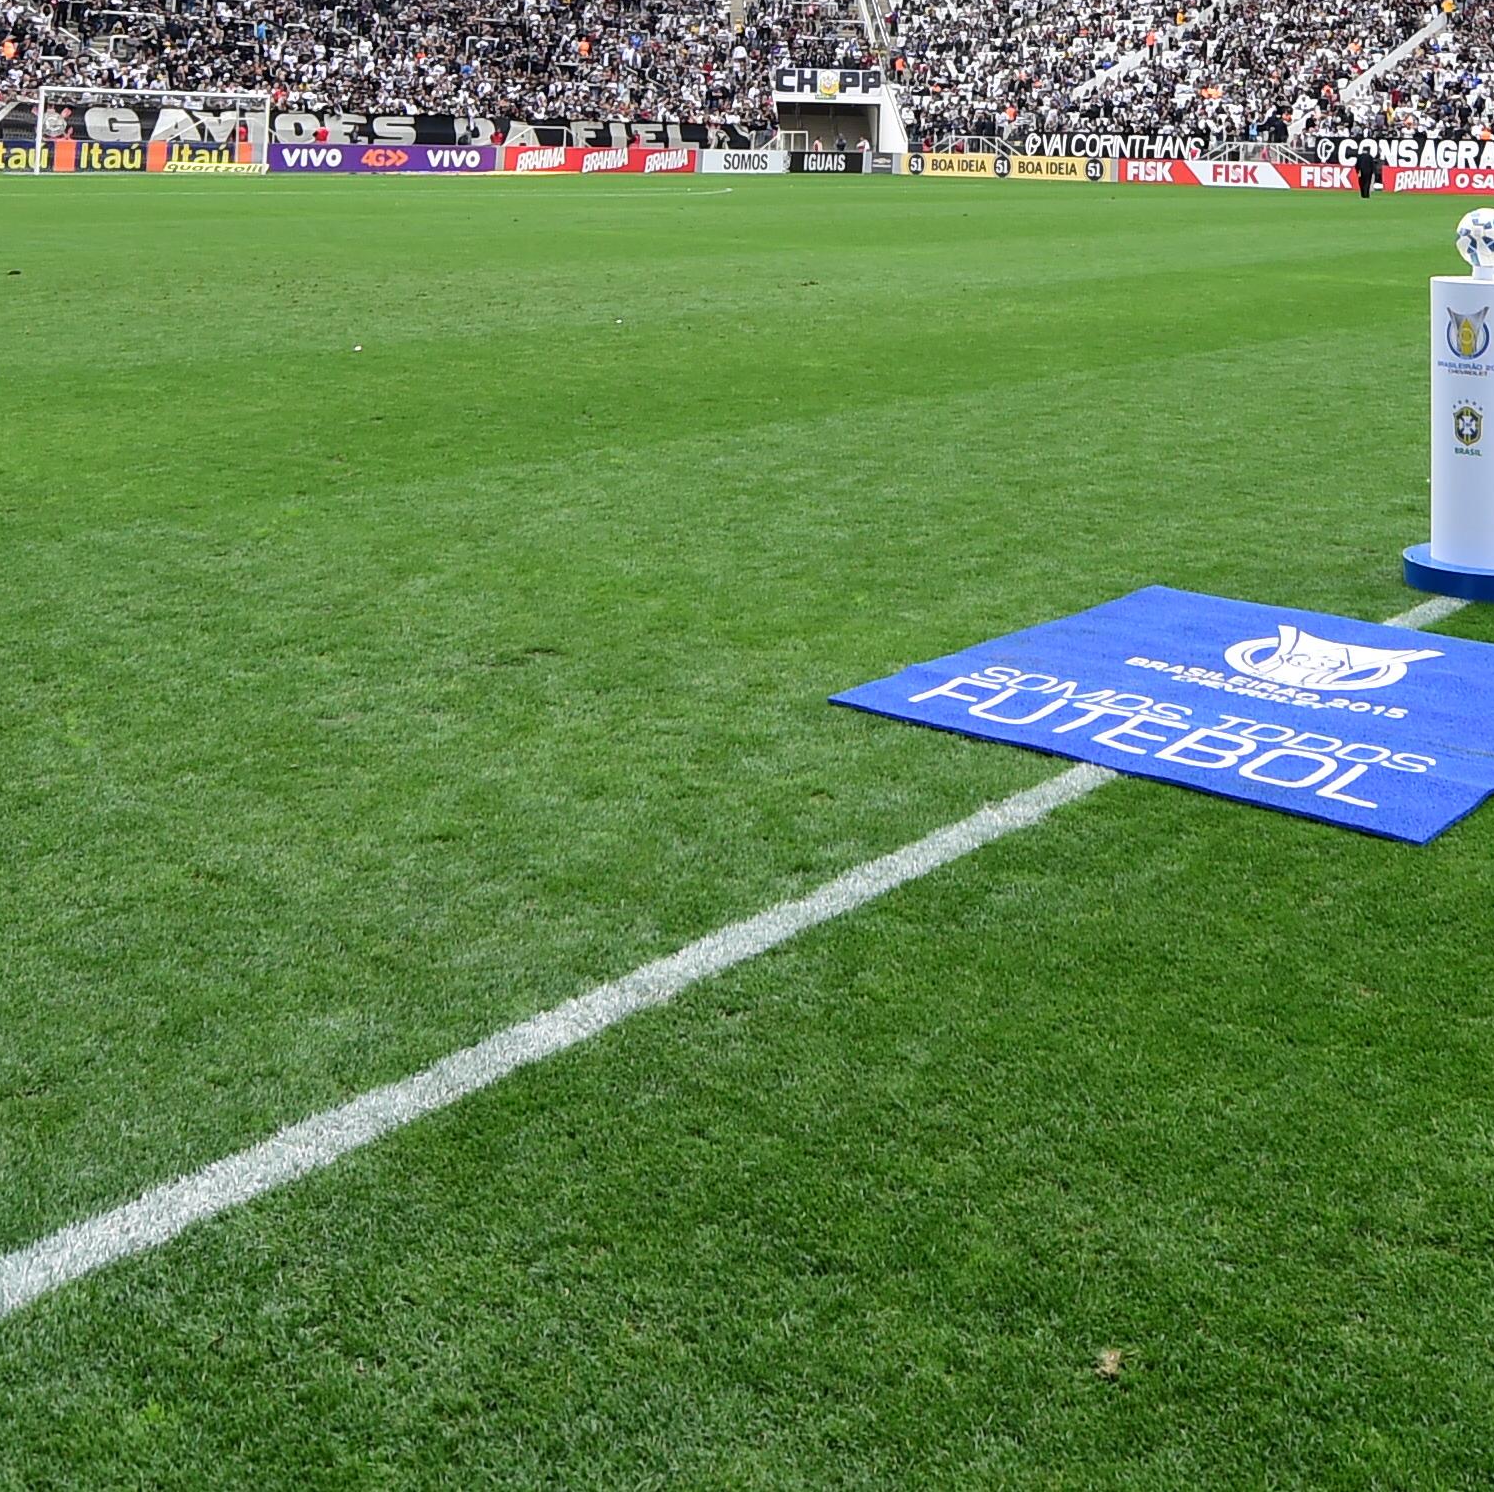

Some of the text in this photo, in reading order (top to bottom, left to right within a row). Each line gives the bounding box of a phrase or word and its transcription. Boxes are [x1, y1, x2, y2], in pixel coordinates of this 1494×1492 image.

[776, 68, 881, 94] CHPP
[80, 141, 142, 170] Itaú
[171, 142, 230, 163] Itaú
[282, 148, 343, 168] VIVO
[427, 149, 481, 168] VIVO
[1040, 135, 1067, 157] VAI
[1070, 135, 1205, 159] CORINTHIANS
[516, 147, 565, 172] BRAHMA
[582, 148, 629, 173] BRAHMA
[644, 150, 689, 173] BRAHMA
[723, 153, 846, 172] SOMOS IGUAIS
[909, 158, 987, 173] 51 BOA IDEIA
[995, 159, 1077, 175] 51 BOA IDEIA
[1088, 163, 1101, 177] 51
[1127, 161, 1173, 182] FISK
[1212, 164, 1260, 184] FISK
[1300, 166, 1353, 189] FISK
[1394, 168, 1450, 192] BRAHMA
[1456, 173, 1469, 188] O
[1455, 447, 1482, 457] BRASIL
[1125, 656, 1408, 721] BRASILEIRÃO 2015
[968, 665, 1438, 775] SOMOS TODOS
[908, 677, 1379, 810] FUTEBOL
